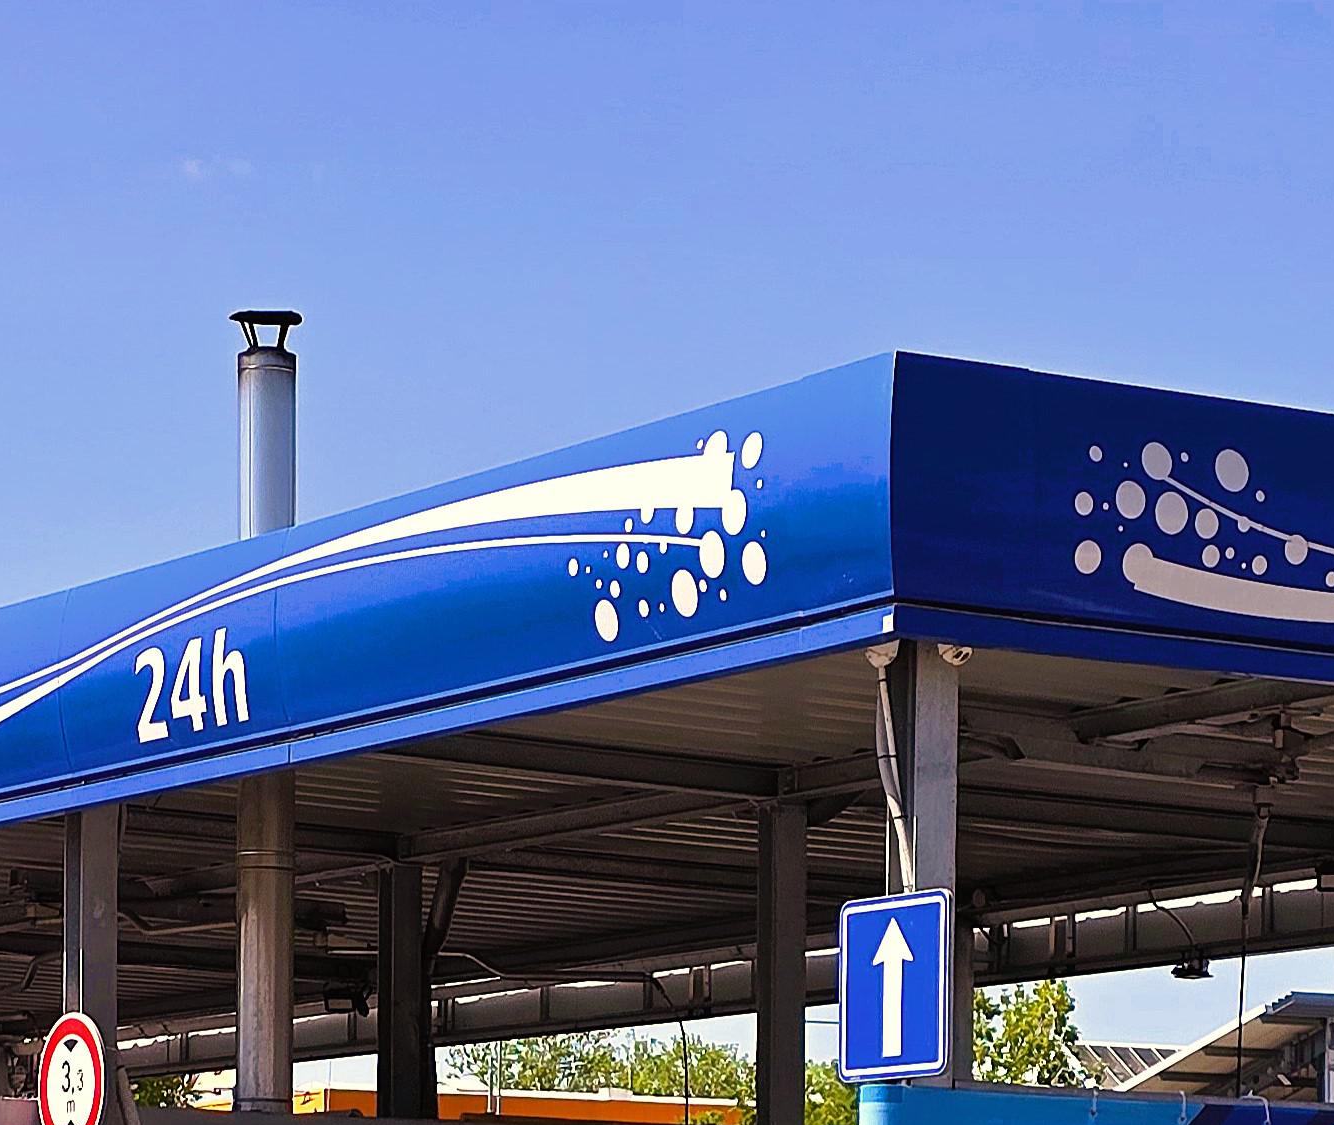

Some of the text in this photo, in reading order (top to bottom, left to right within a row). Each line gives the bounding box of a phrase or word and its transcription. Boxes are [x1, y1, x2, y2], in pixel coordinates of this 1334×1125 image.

[134, 626, 249, 743] 24h
[61, 1060, 84, 1094] 3,3
[66, 1099, 76, 1114] m
